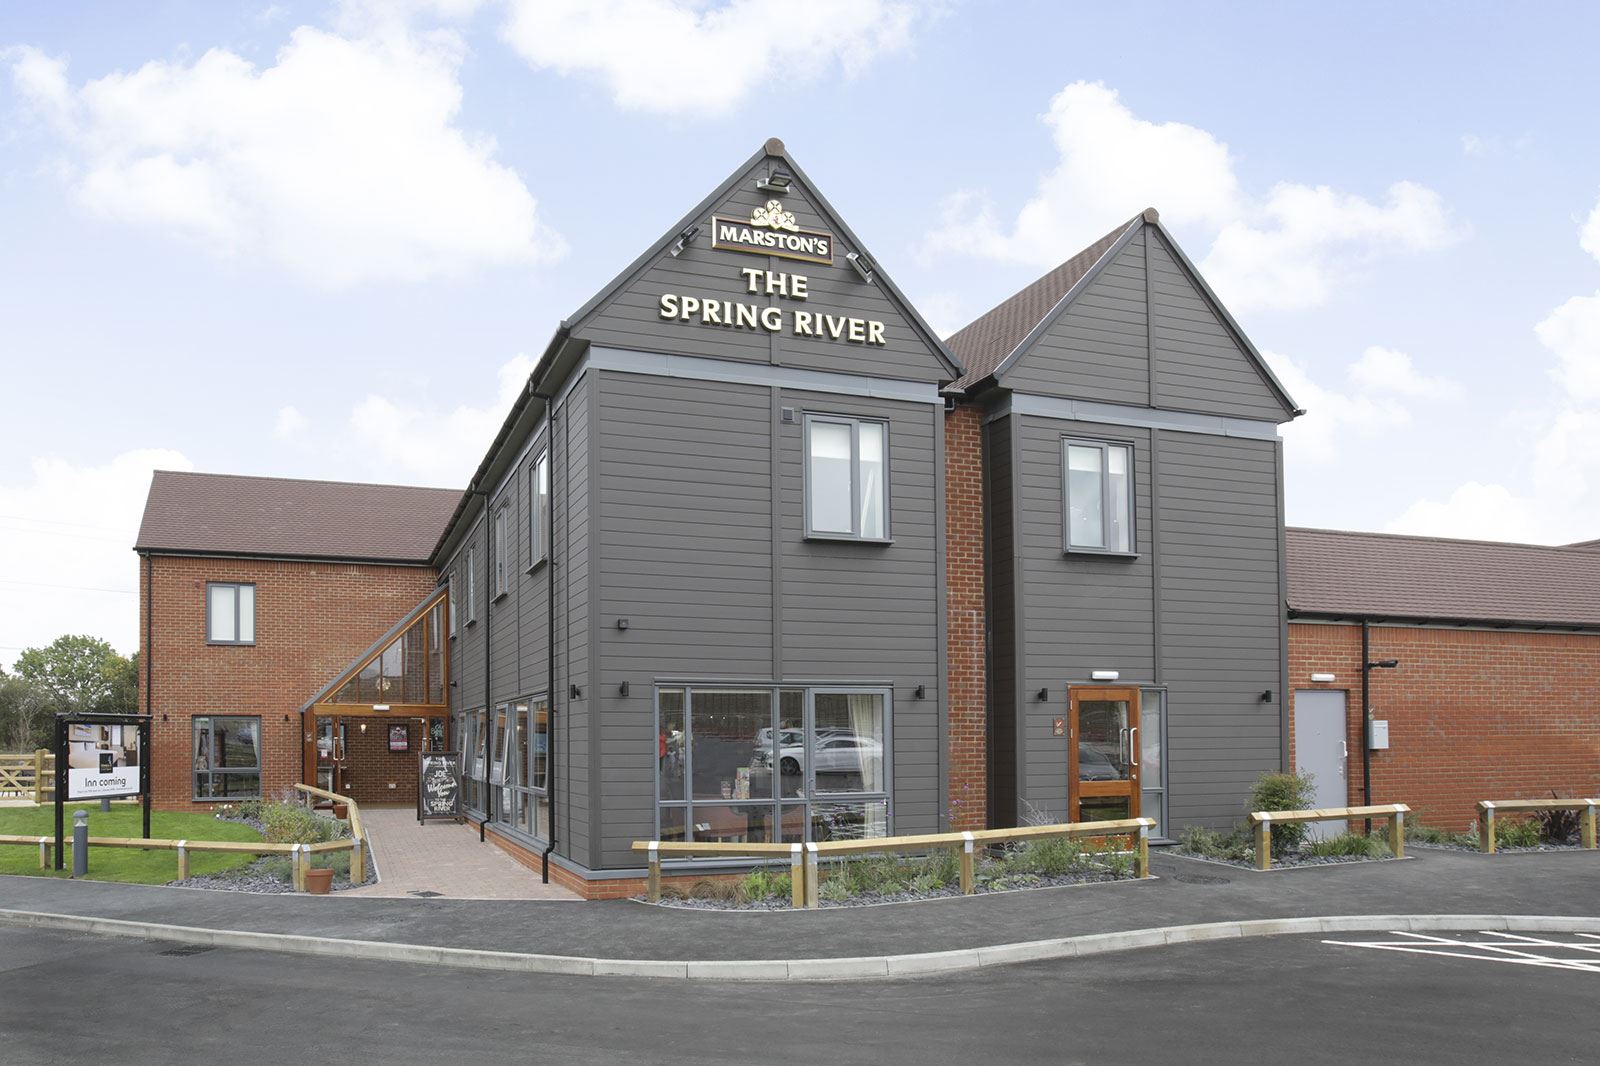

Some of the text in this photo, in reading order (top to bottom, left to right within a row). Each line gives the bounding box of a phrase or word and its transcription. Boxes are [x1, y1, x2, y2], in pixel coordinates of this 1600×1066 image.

[719, 225, 829, 256] MARSTON'S
[742, 267, 809, 300] THE
[659, 294, 887, 345] SPRING RIVER
[85, 777, 126, 787] Inn coming
